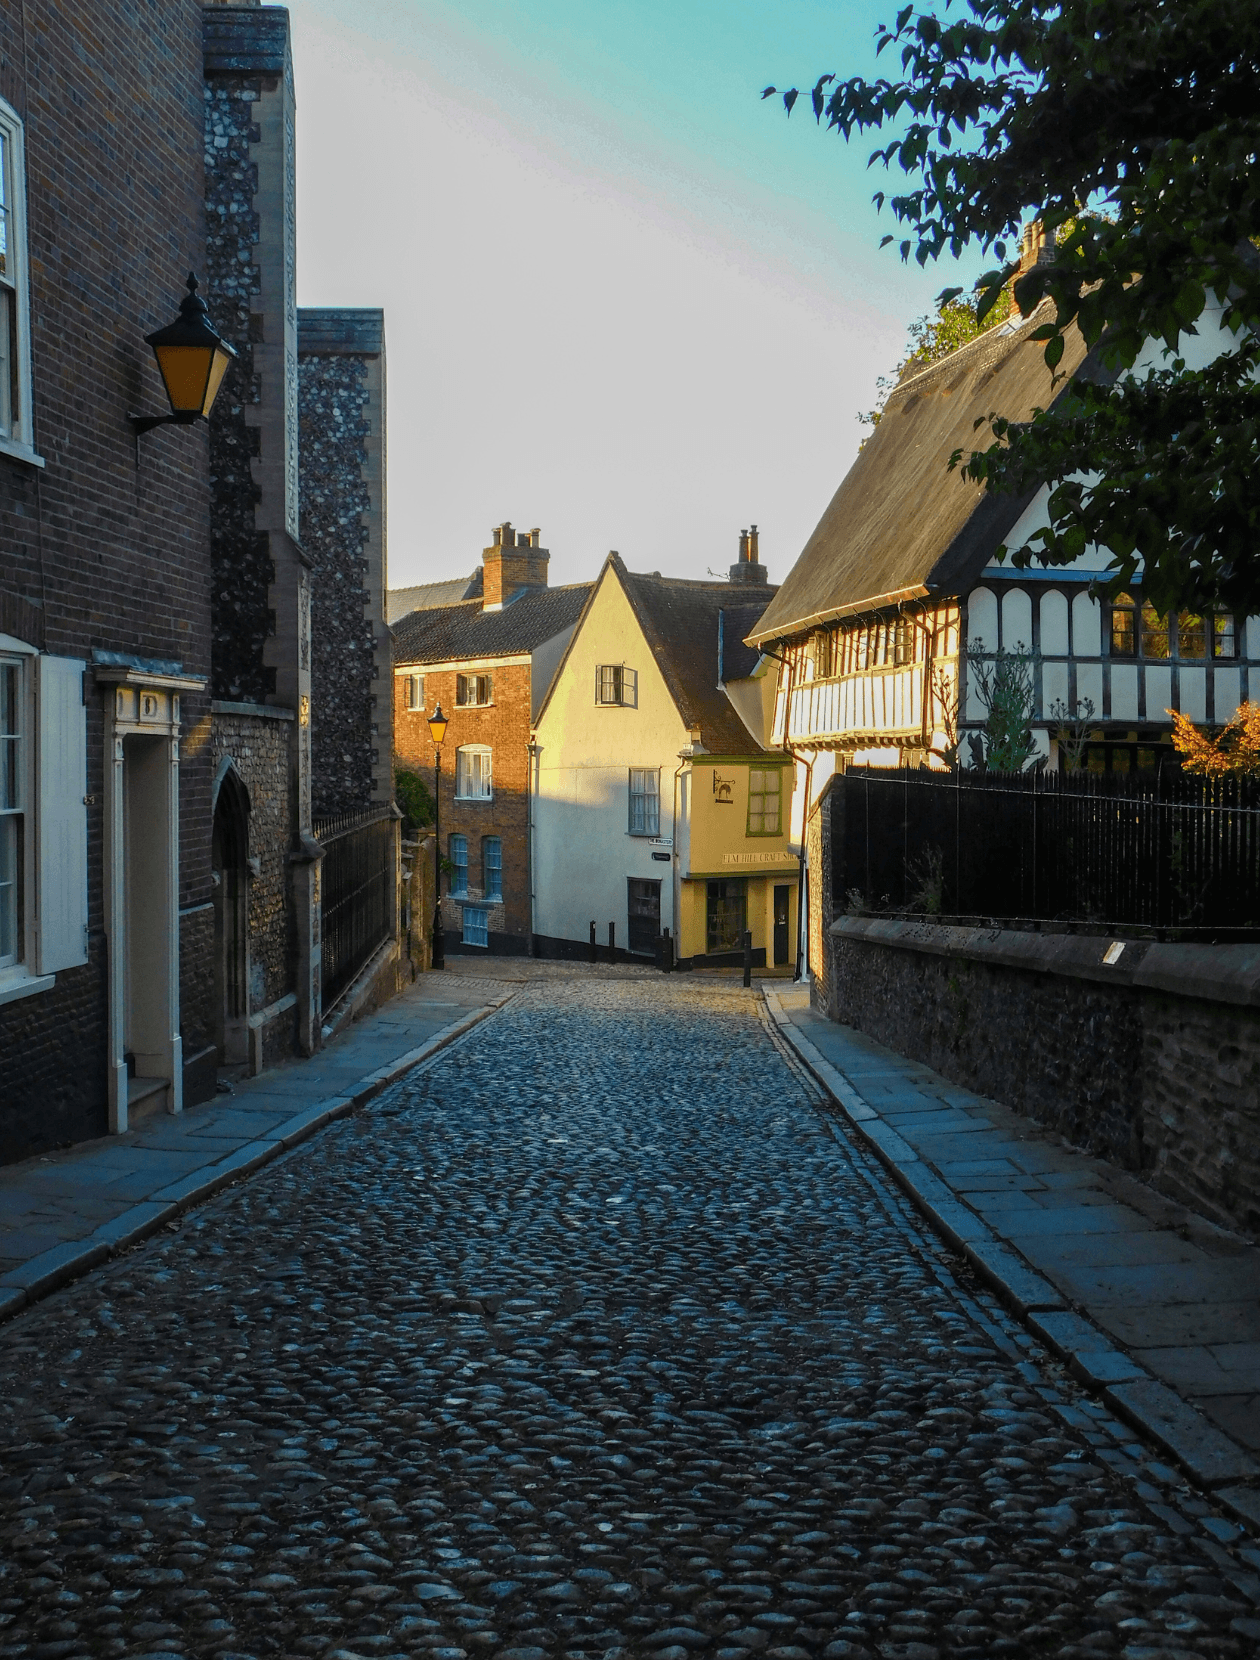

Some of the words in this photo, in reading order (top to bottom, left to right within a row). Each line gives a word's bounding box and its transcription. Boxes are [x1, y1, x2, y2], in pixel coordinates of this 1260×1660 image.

[723, 854, 739, 863] ELM
[741, 854, 757, 863] HILL
[759, 853, 781, 862] CRAFT
[783, 853, 797, 861] SHO
